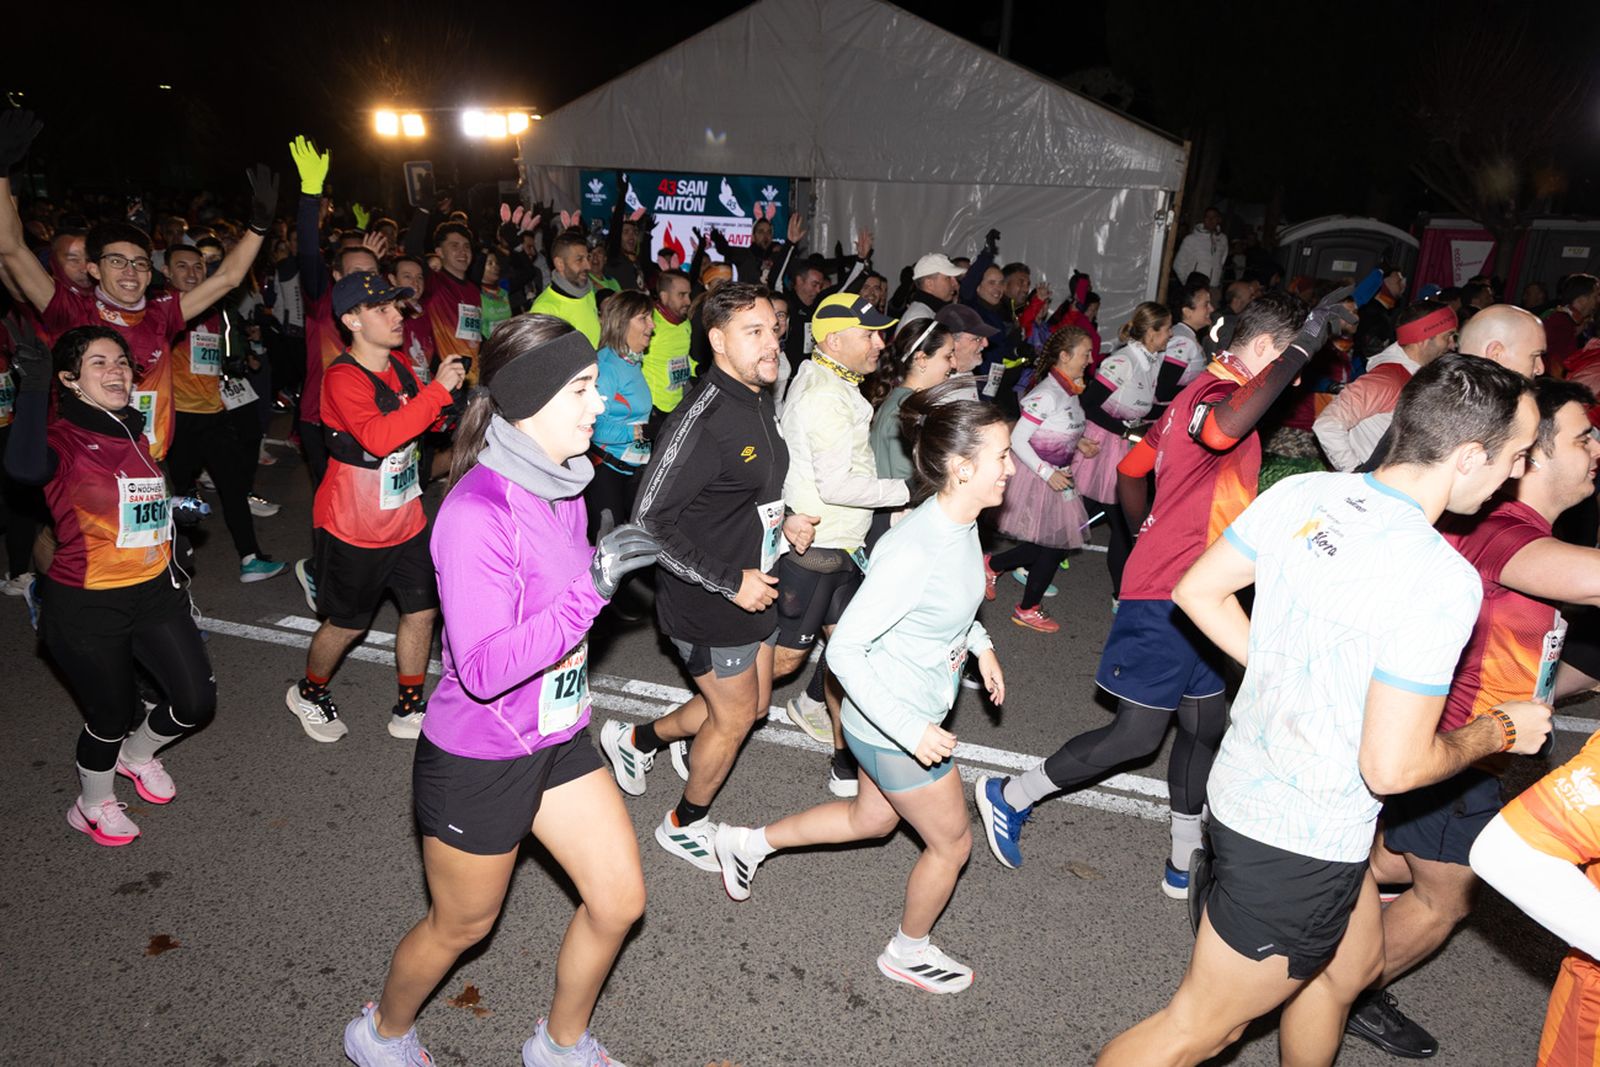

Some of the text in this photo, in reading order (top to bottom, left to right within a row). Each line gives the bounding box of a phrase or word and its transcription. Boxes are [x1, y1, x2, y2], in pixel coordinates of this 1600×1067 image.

[657, 178, 708, 196] 43 SAN
[654, 193, 706, 213] ANTÓN
[676, 418, 691, 442] umbro
[650, 467, 665, 492] umbro
[129, 495, 144, 503] SAN
